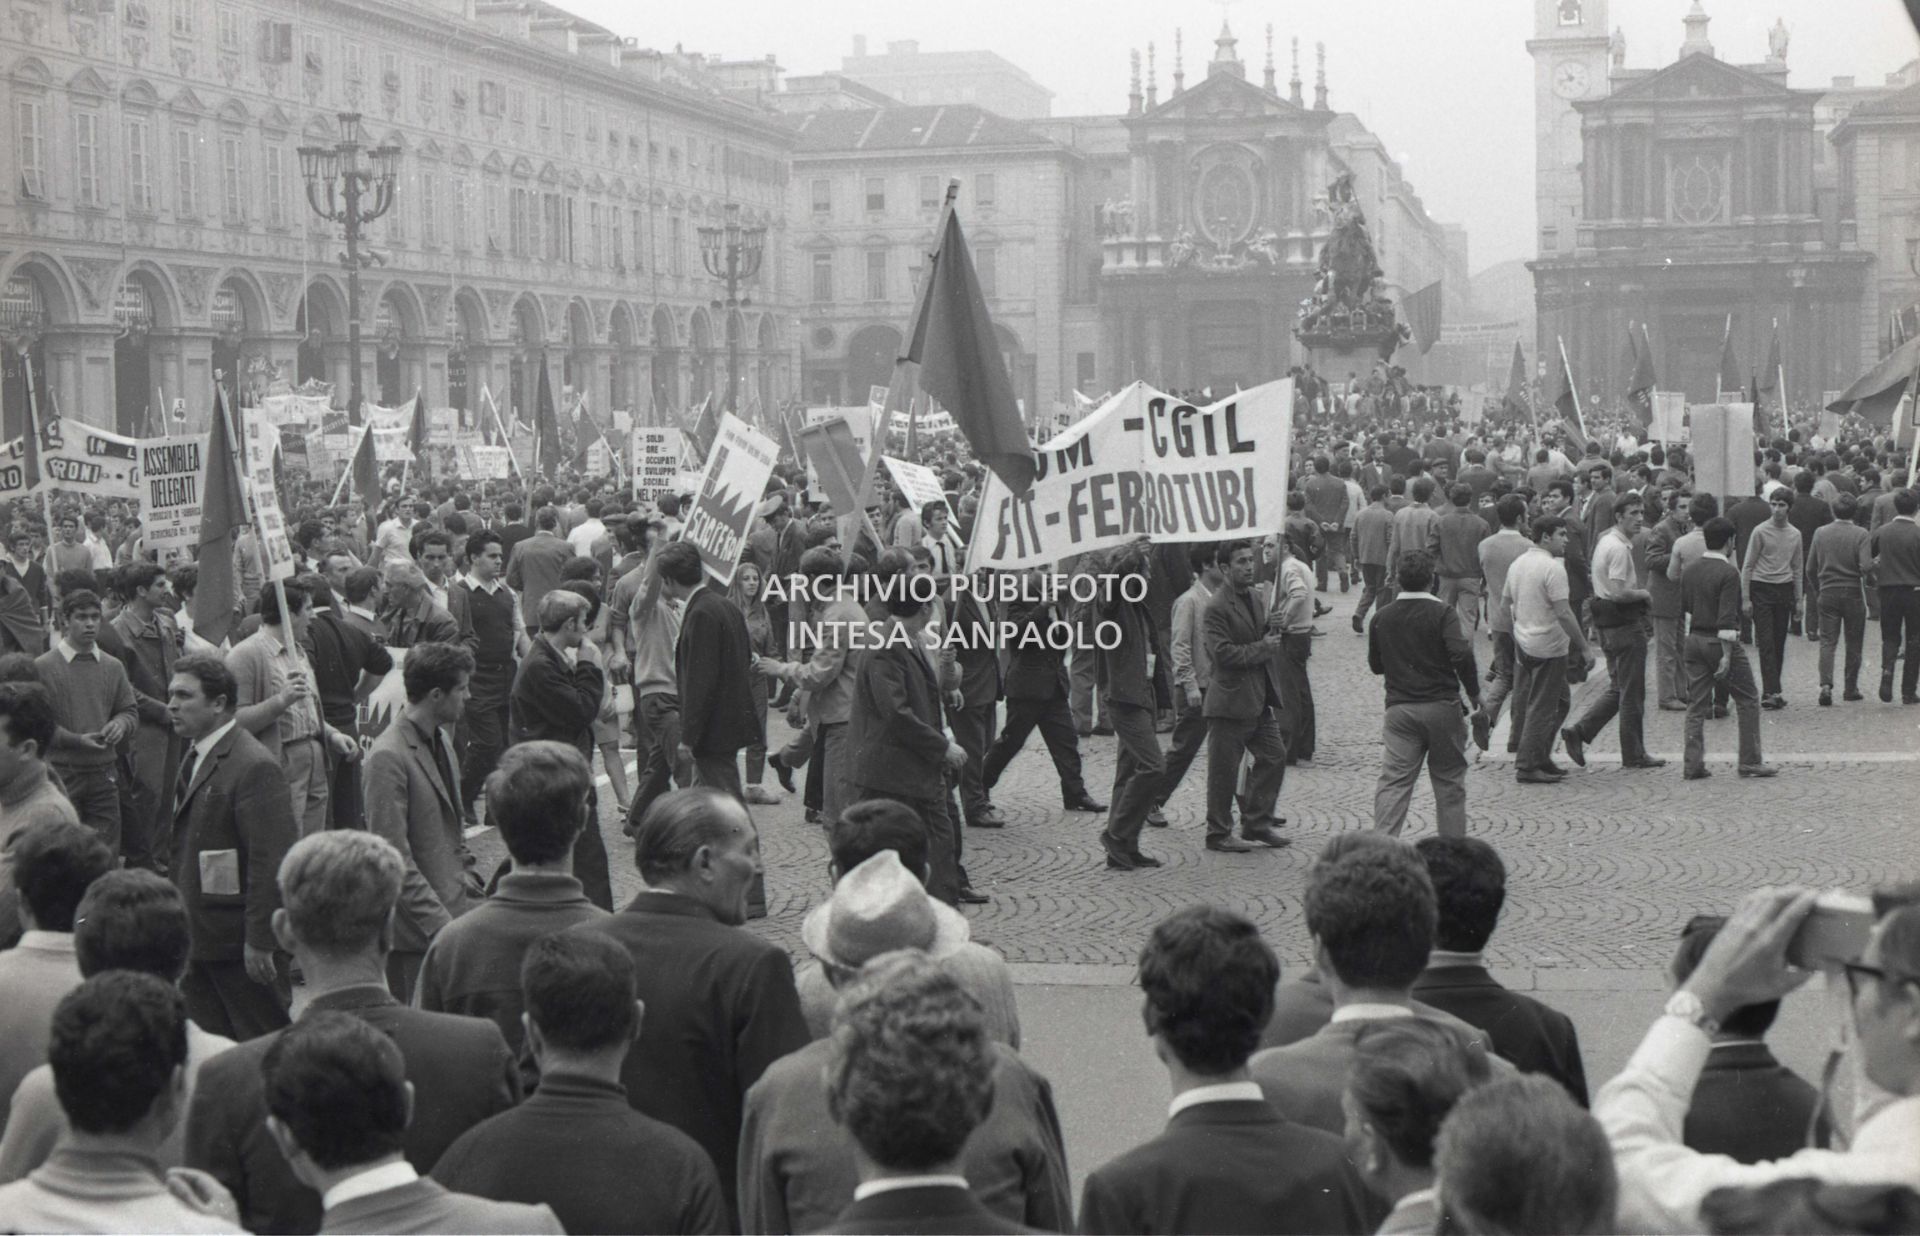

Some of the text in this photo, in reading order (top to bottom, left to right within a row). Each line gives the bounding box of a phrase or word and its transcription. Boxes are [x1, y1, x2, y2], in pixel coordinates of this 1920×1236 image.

[143, 443, 200, 477] ASSEMBLEA
[646, 456, 676, 464] OCCUPATI
[645, 466, 676, 476] SVILUPPO
[643, 477, 669, 486] SOCIALE
[150, 476, 197, 509] DELEGATI
